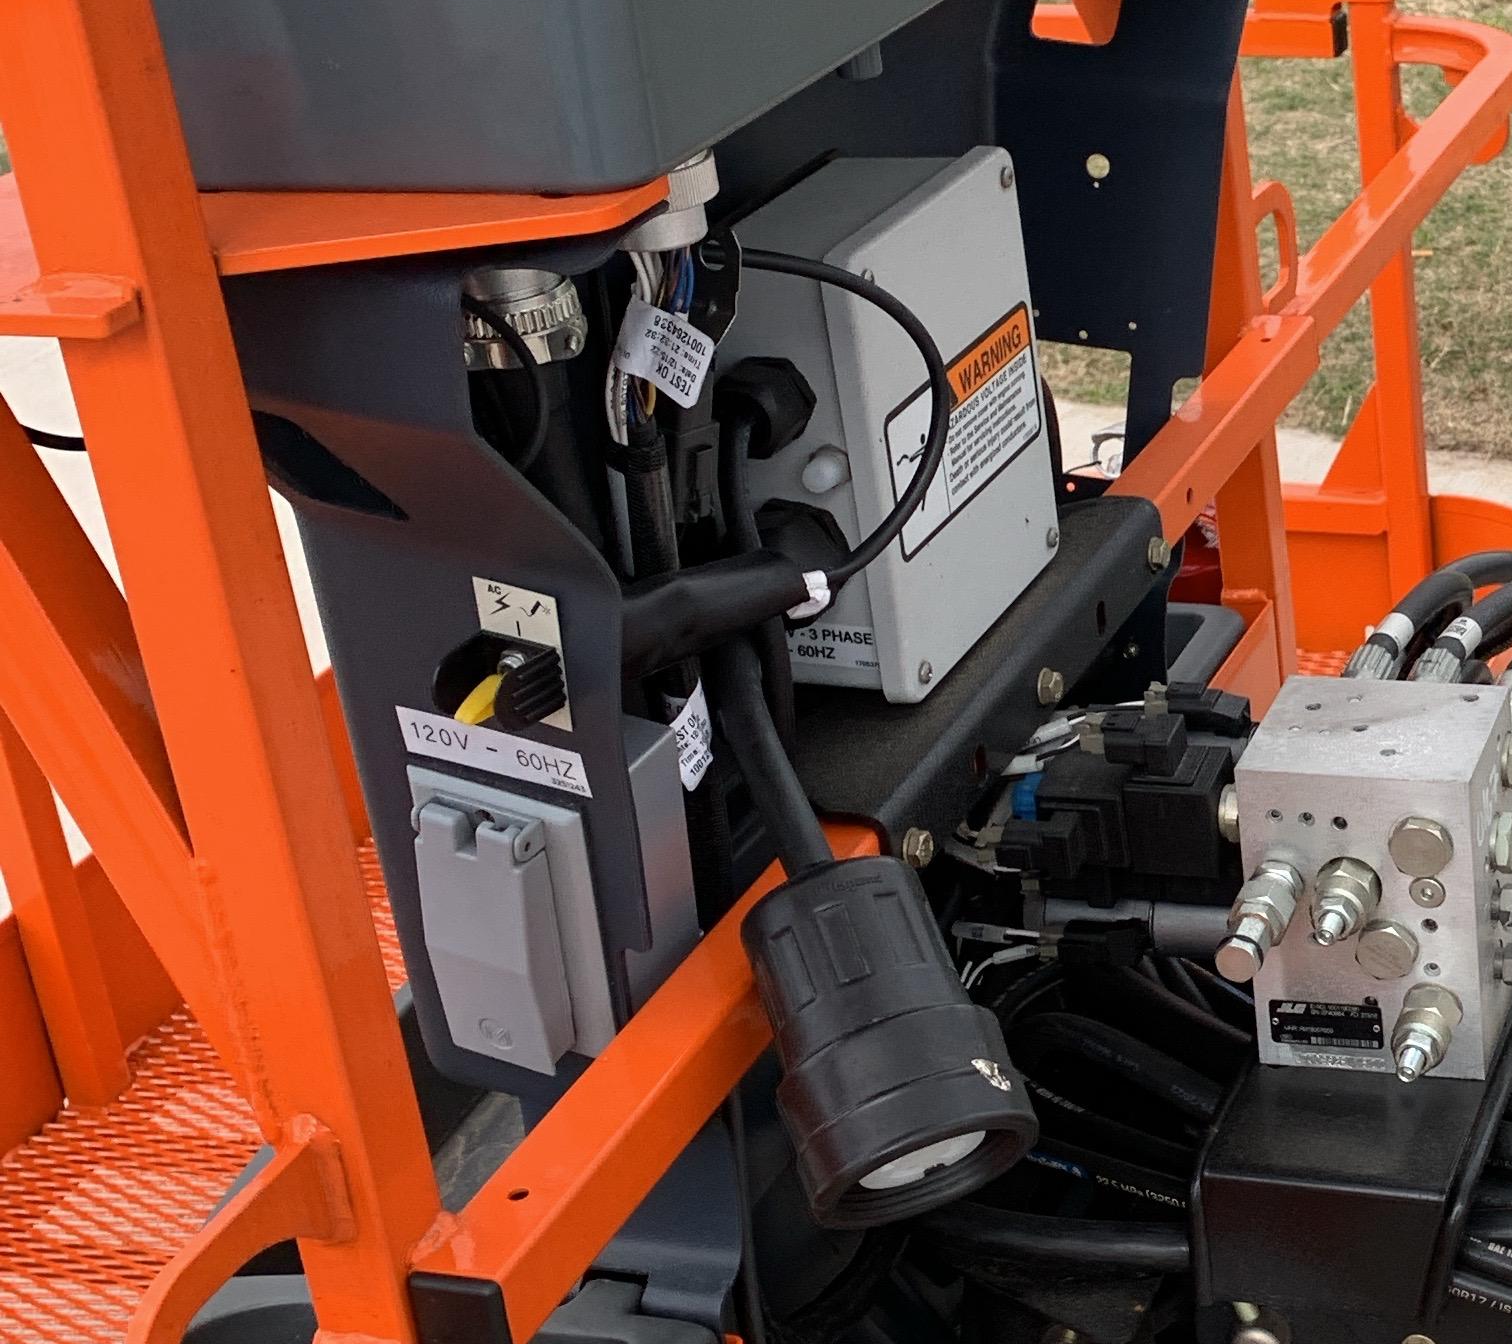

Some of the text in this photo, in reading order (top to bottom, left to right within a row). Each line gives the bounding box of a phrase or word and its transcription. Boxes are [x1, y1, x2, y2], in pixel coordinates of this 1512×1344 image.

[959, 325, 1020, 392] WARNING
[656, 362, 692, 396] TEST OK
[950, 353, 1026, 429] ZARDOUS VOLTAGE INSIDE
[487, 584, 502, 595] AC
[797, 644, 836, 659] 60HZ
[808, 628, 818, 640] 3
[822, 629, 873, 645] PHASE
[411, 721, 469, 750] 120V
[516, 749, 577, 781] 60HZ
